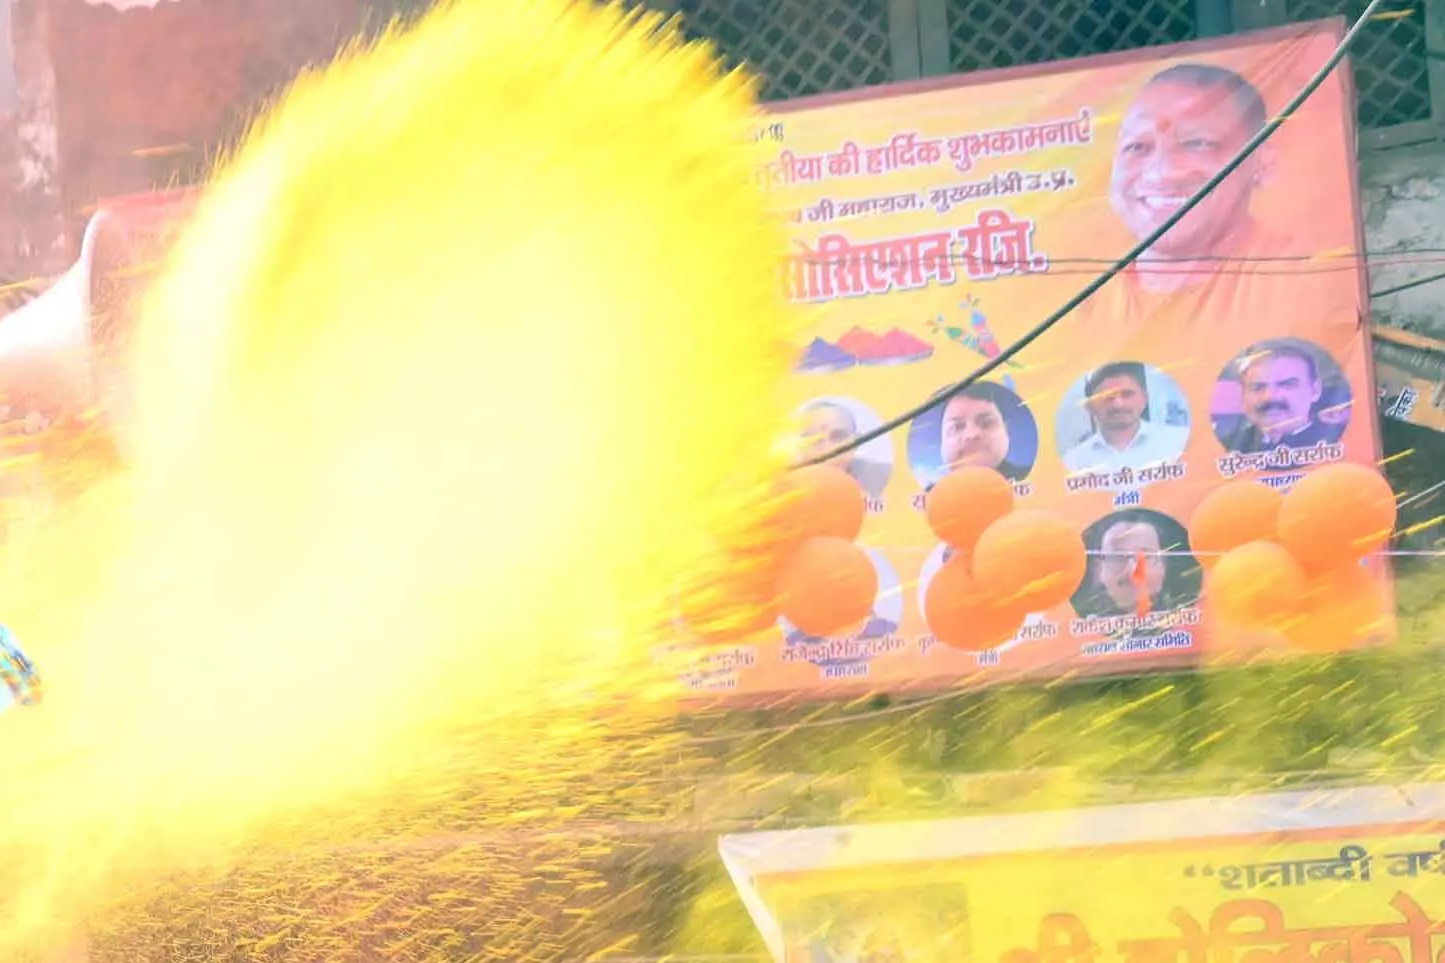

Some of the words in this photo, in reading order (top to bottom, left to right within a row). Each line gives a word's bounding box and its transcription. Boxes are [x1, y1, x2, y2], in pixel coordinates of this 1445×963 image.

[827, 141, 860, 175] की
[867, 132, 942, 175] हार्दिक
[947, 109, 1092, 172] शुभकामनाएं
[807, 199, 834, 223] जी
[959, 210, 1047, 278] रजि.
